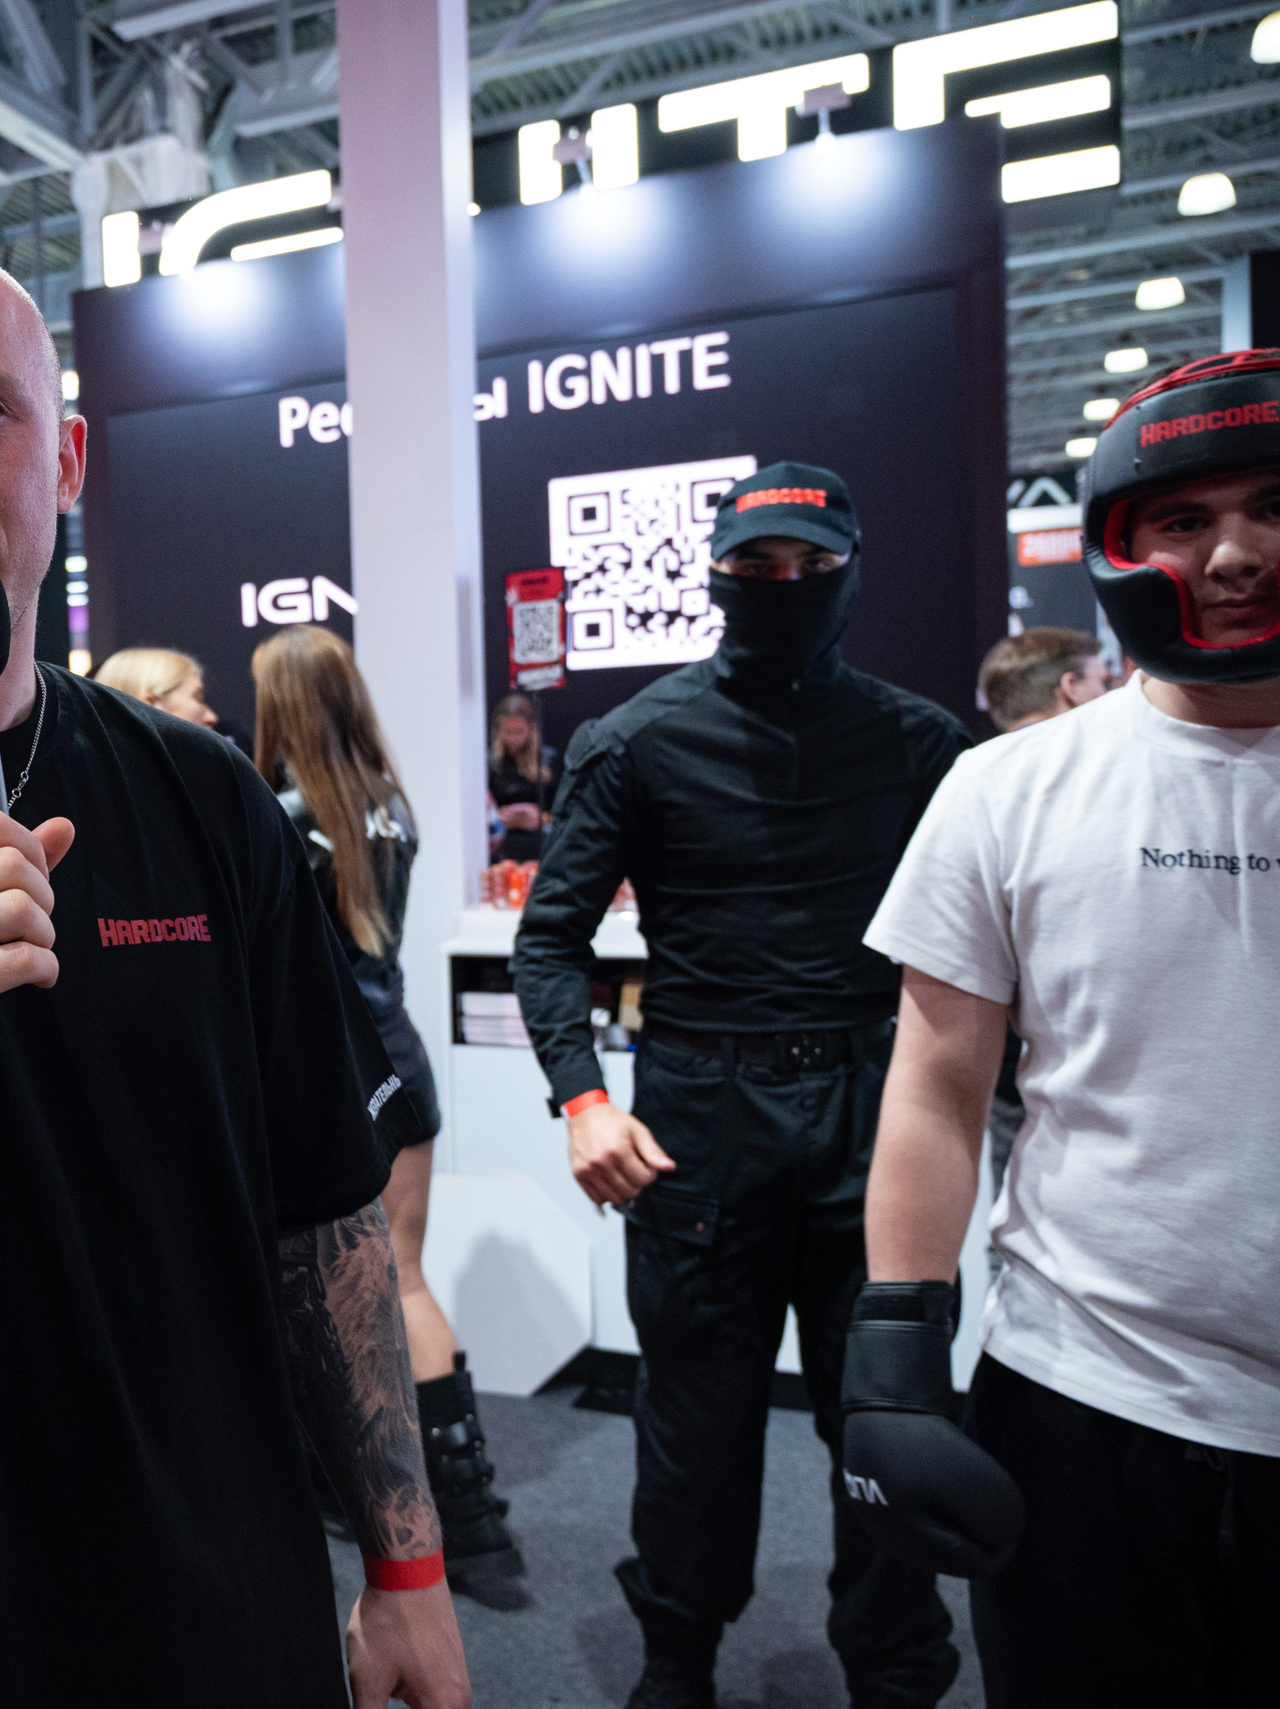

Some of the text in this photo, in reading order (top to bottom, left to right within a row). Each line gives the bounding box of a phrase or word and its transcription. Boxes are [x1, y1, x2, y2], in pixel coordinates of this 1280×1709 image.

[528, 331, 731, 414] IGNITE
[1140, 401, 1279, 447] HARDCORE
[240, 573, 359, 628] IGN
[1140, 847, 1241, 875] Nothing
[1247, 853, 1271, 872] to
[97, 914, 211, 947] HARDCORE
